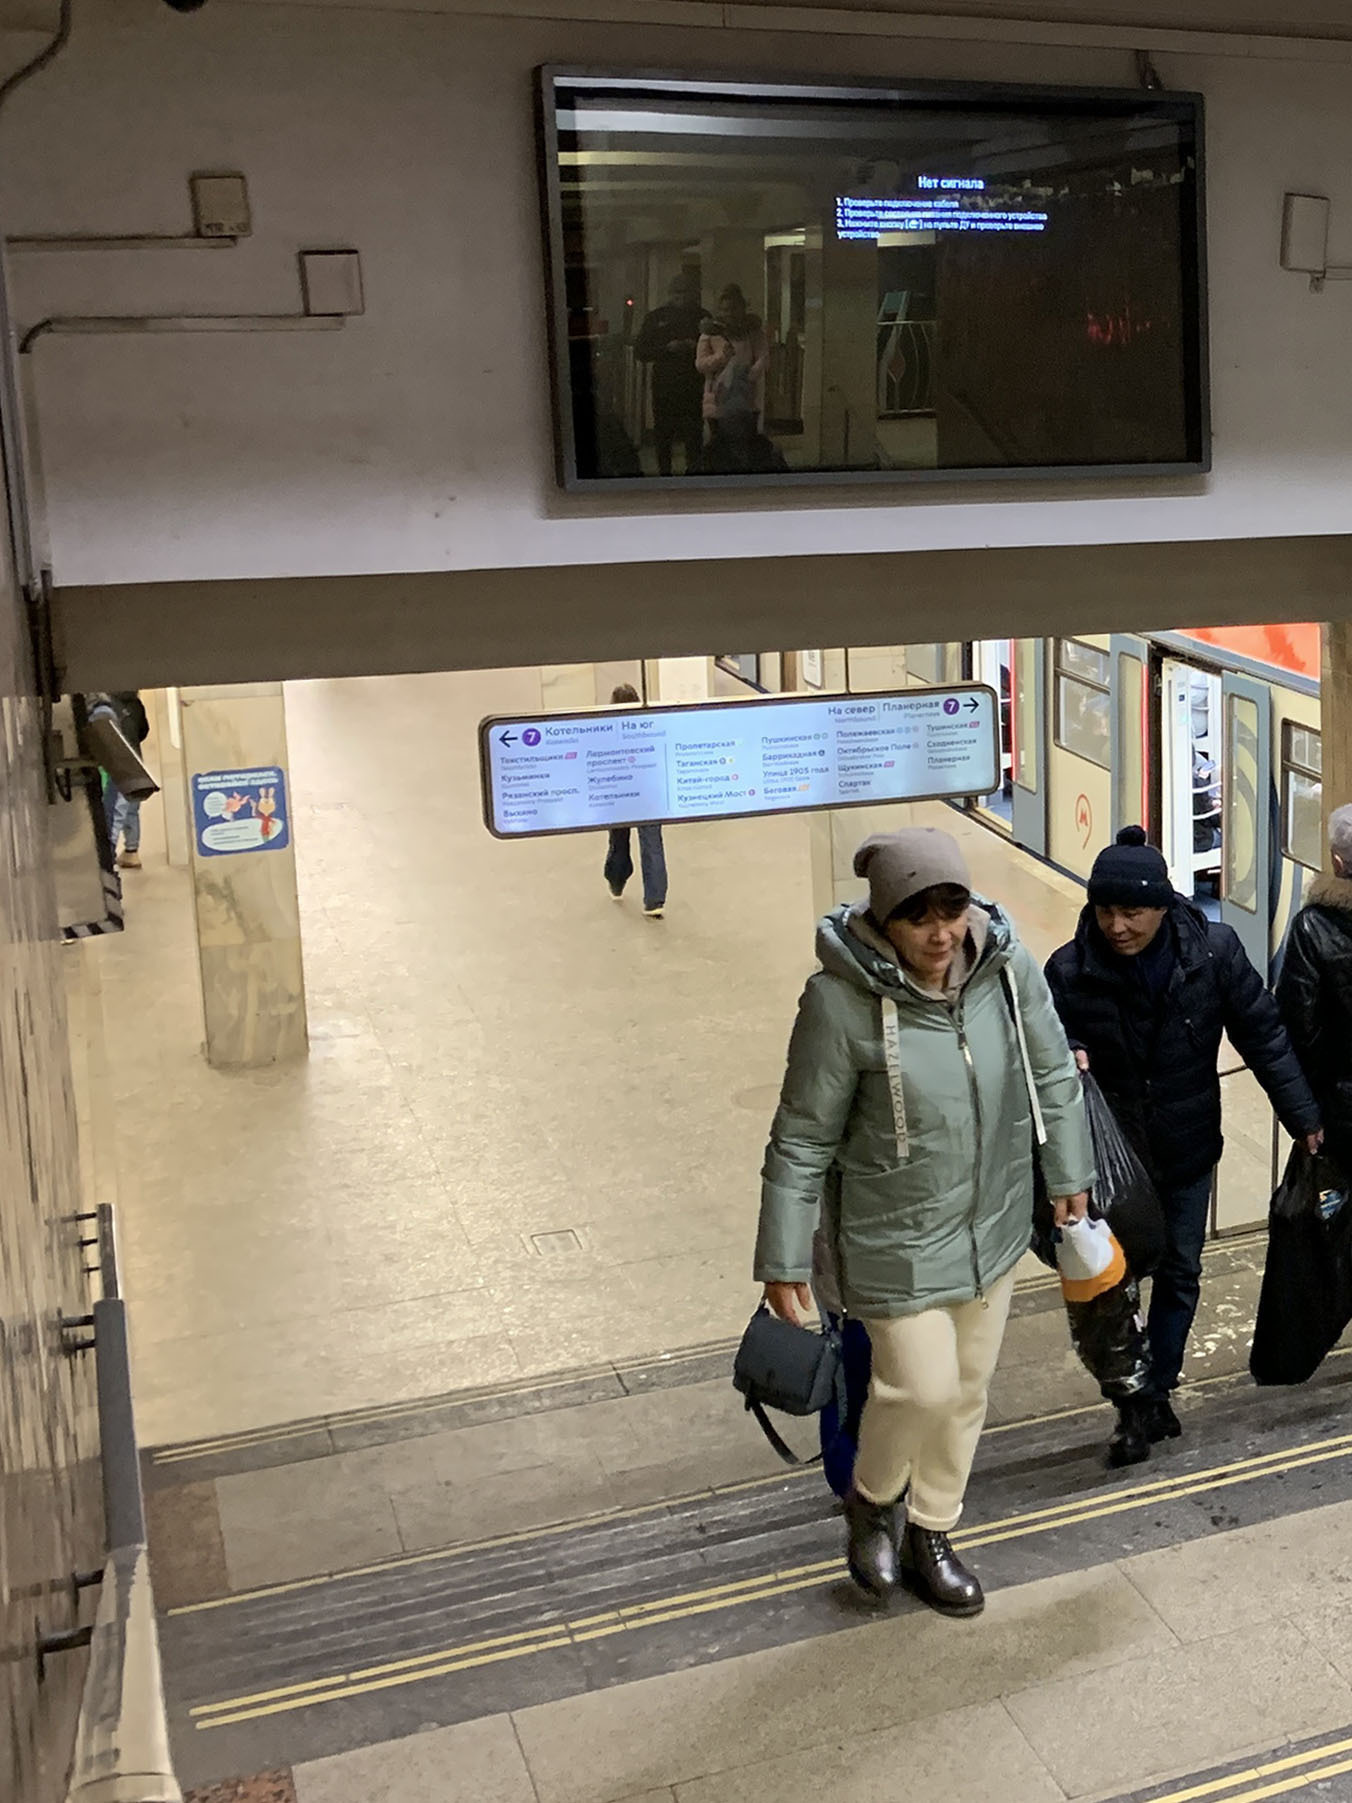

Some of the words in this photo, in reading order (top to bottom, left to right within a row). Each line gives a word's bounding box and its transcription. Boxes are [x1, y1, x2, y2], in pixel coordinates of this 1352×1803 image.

[918, 176, 939, 189] Нет
[940, 179, 985, 190] сигнала
[828, 707, 842, 715] На
[844, 706, 876, 714] север
[883, 701, 939, 711] Планерная
[545, 725, 613, 736] Котельники
[621, 721, 637, 730] На
[640, 721, 654, 730] юг
[789, 767, 809, 775] 1905
[838, 779, 871, 788] Спартак
[724, 790, 746, 798] Мост
